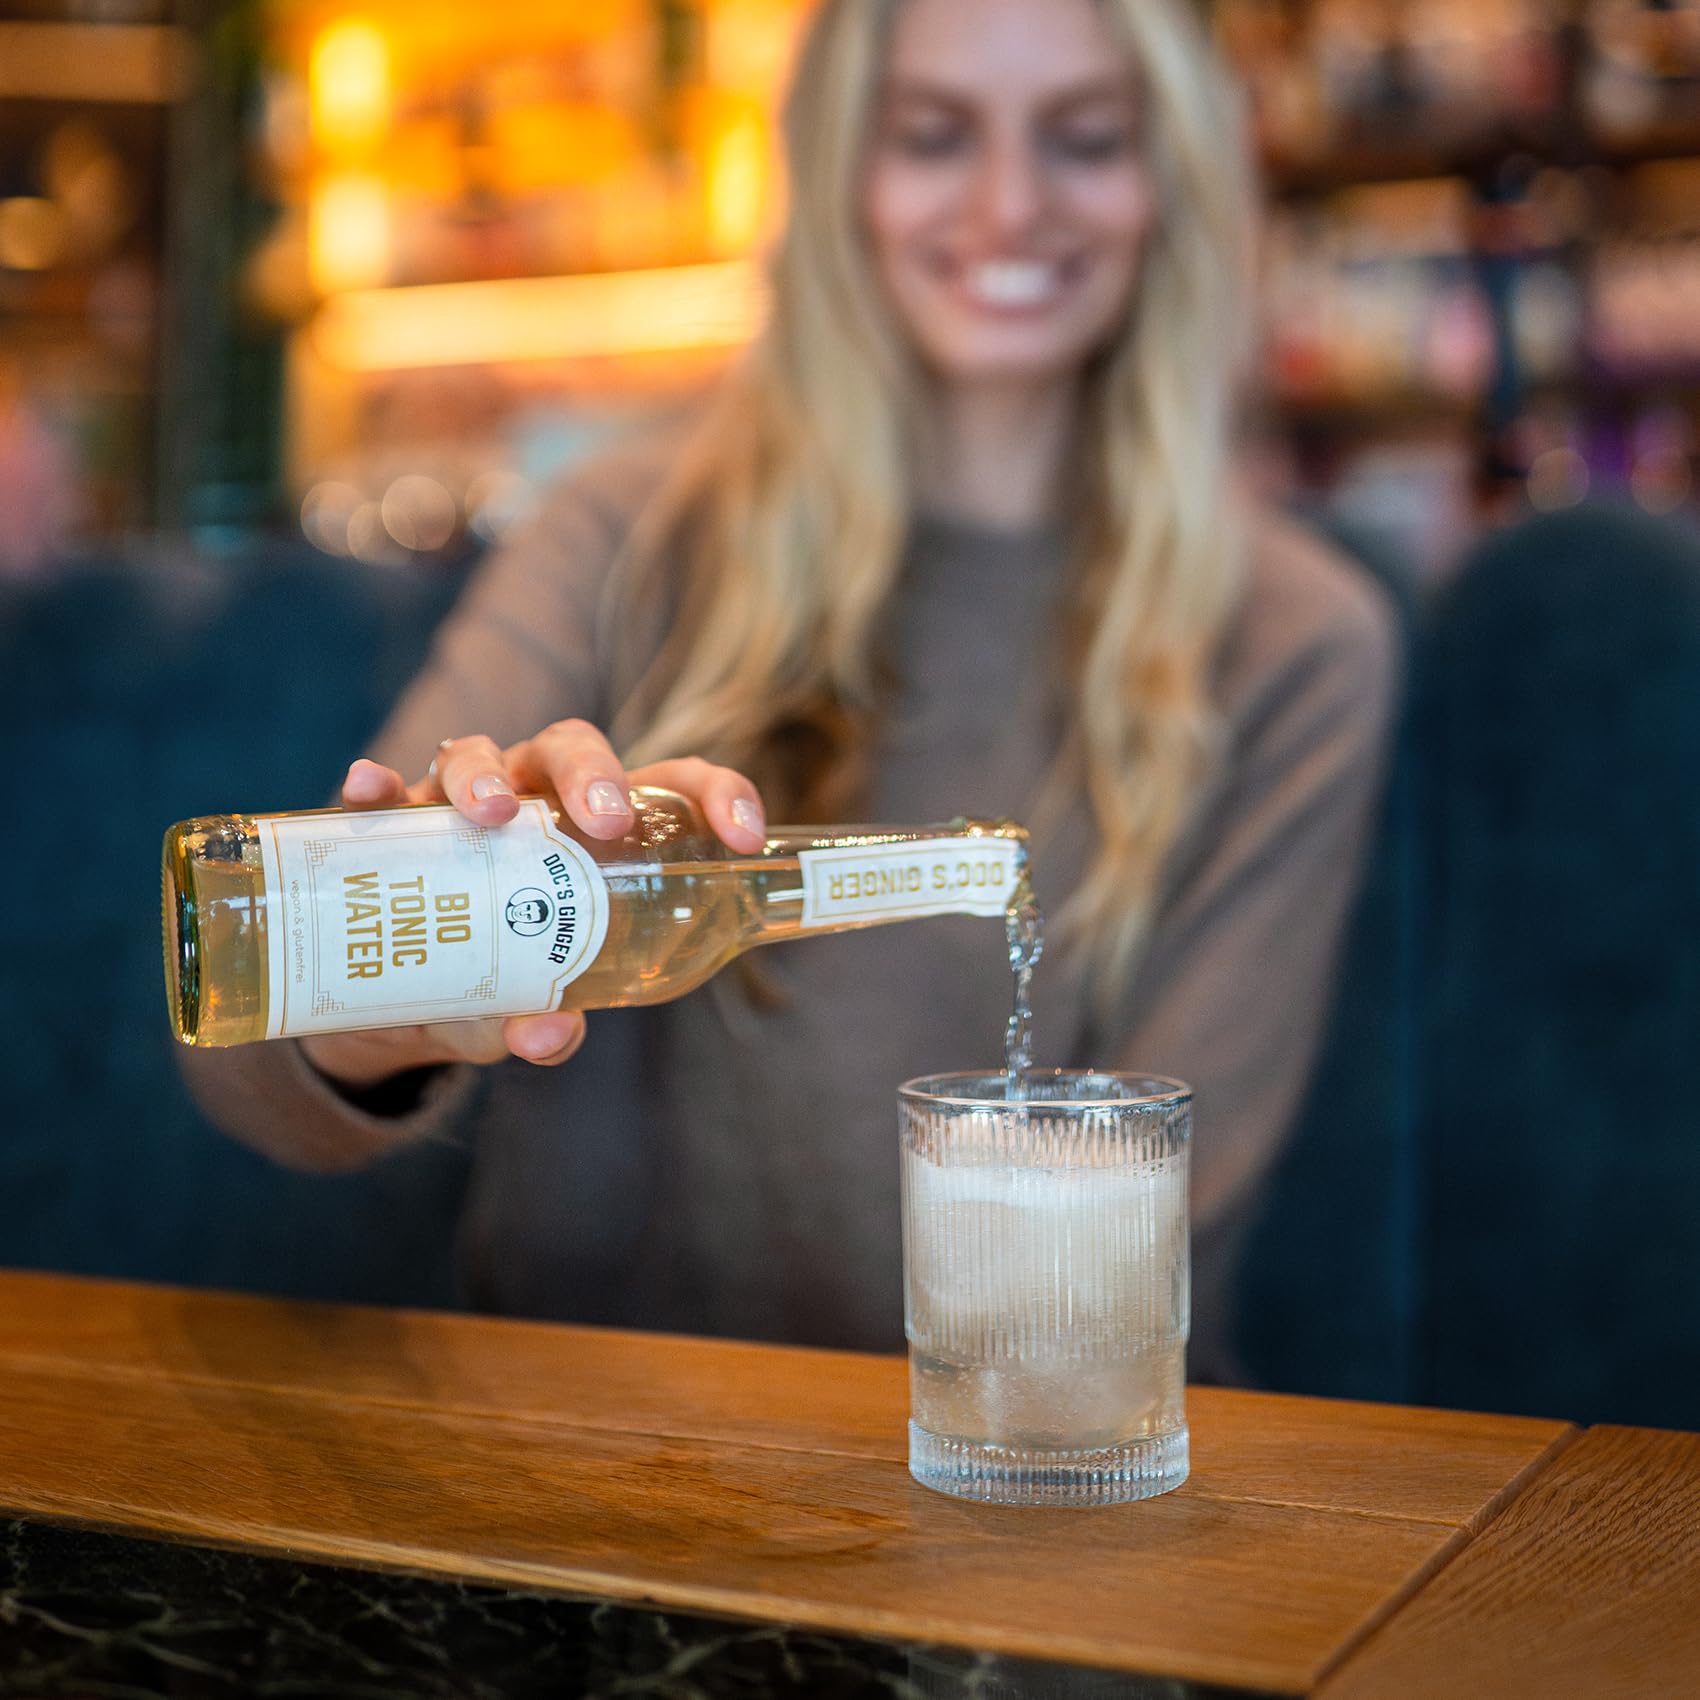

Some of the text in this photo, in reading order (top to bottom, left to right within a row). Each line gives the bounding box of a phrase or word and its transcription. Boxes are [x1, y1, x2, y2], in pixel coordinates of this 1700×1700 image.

[342, 871, 383, 981] WATER
[388, 875, 428, 968] TONIC
[434, 892, 472, 944] BIO
[543, 852, 577, 965] DOC'S GINGER
[829, 861, 1005, 900] DOC'S GINGER
[290, 879, 305, 983] vegan & glutenfrei
